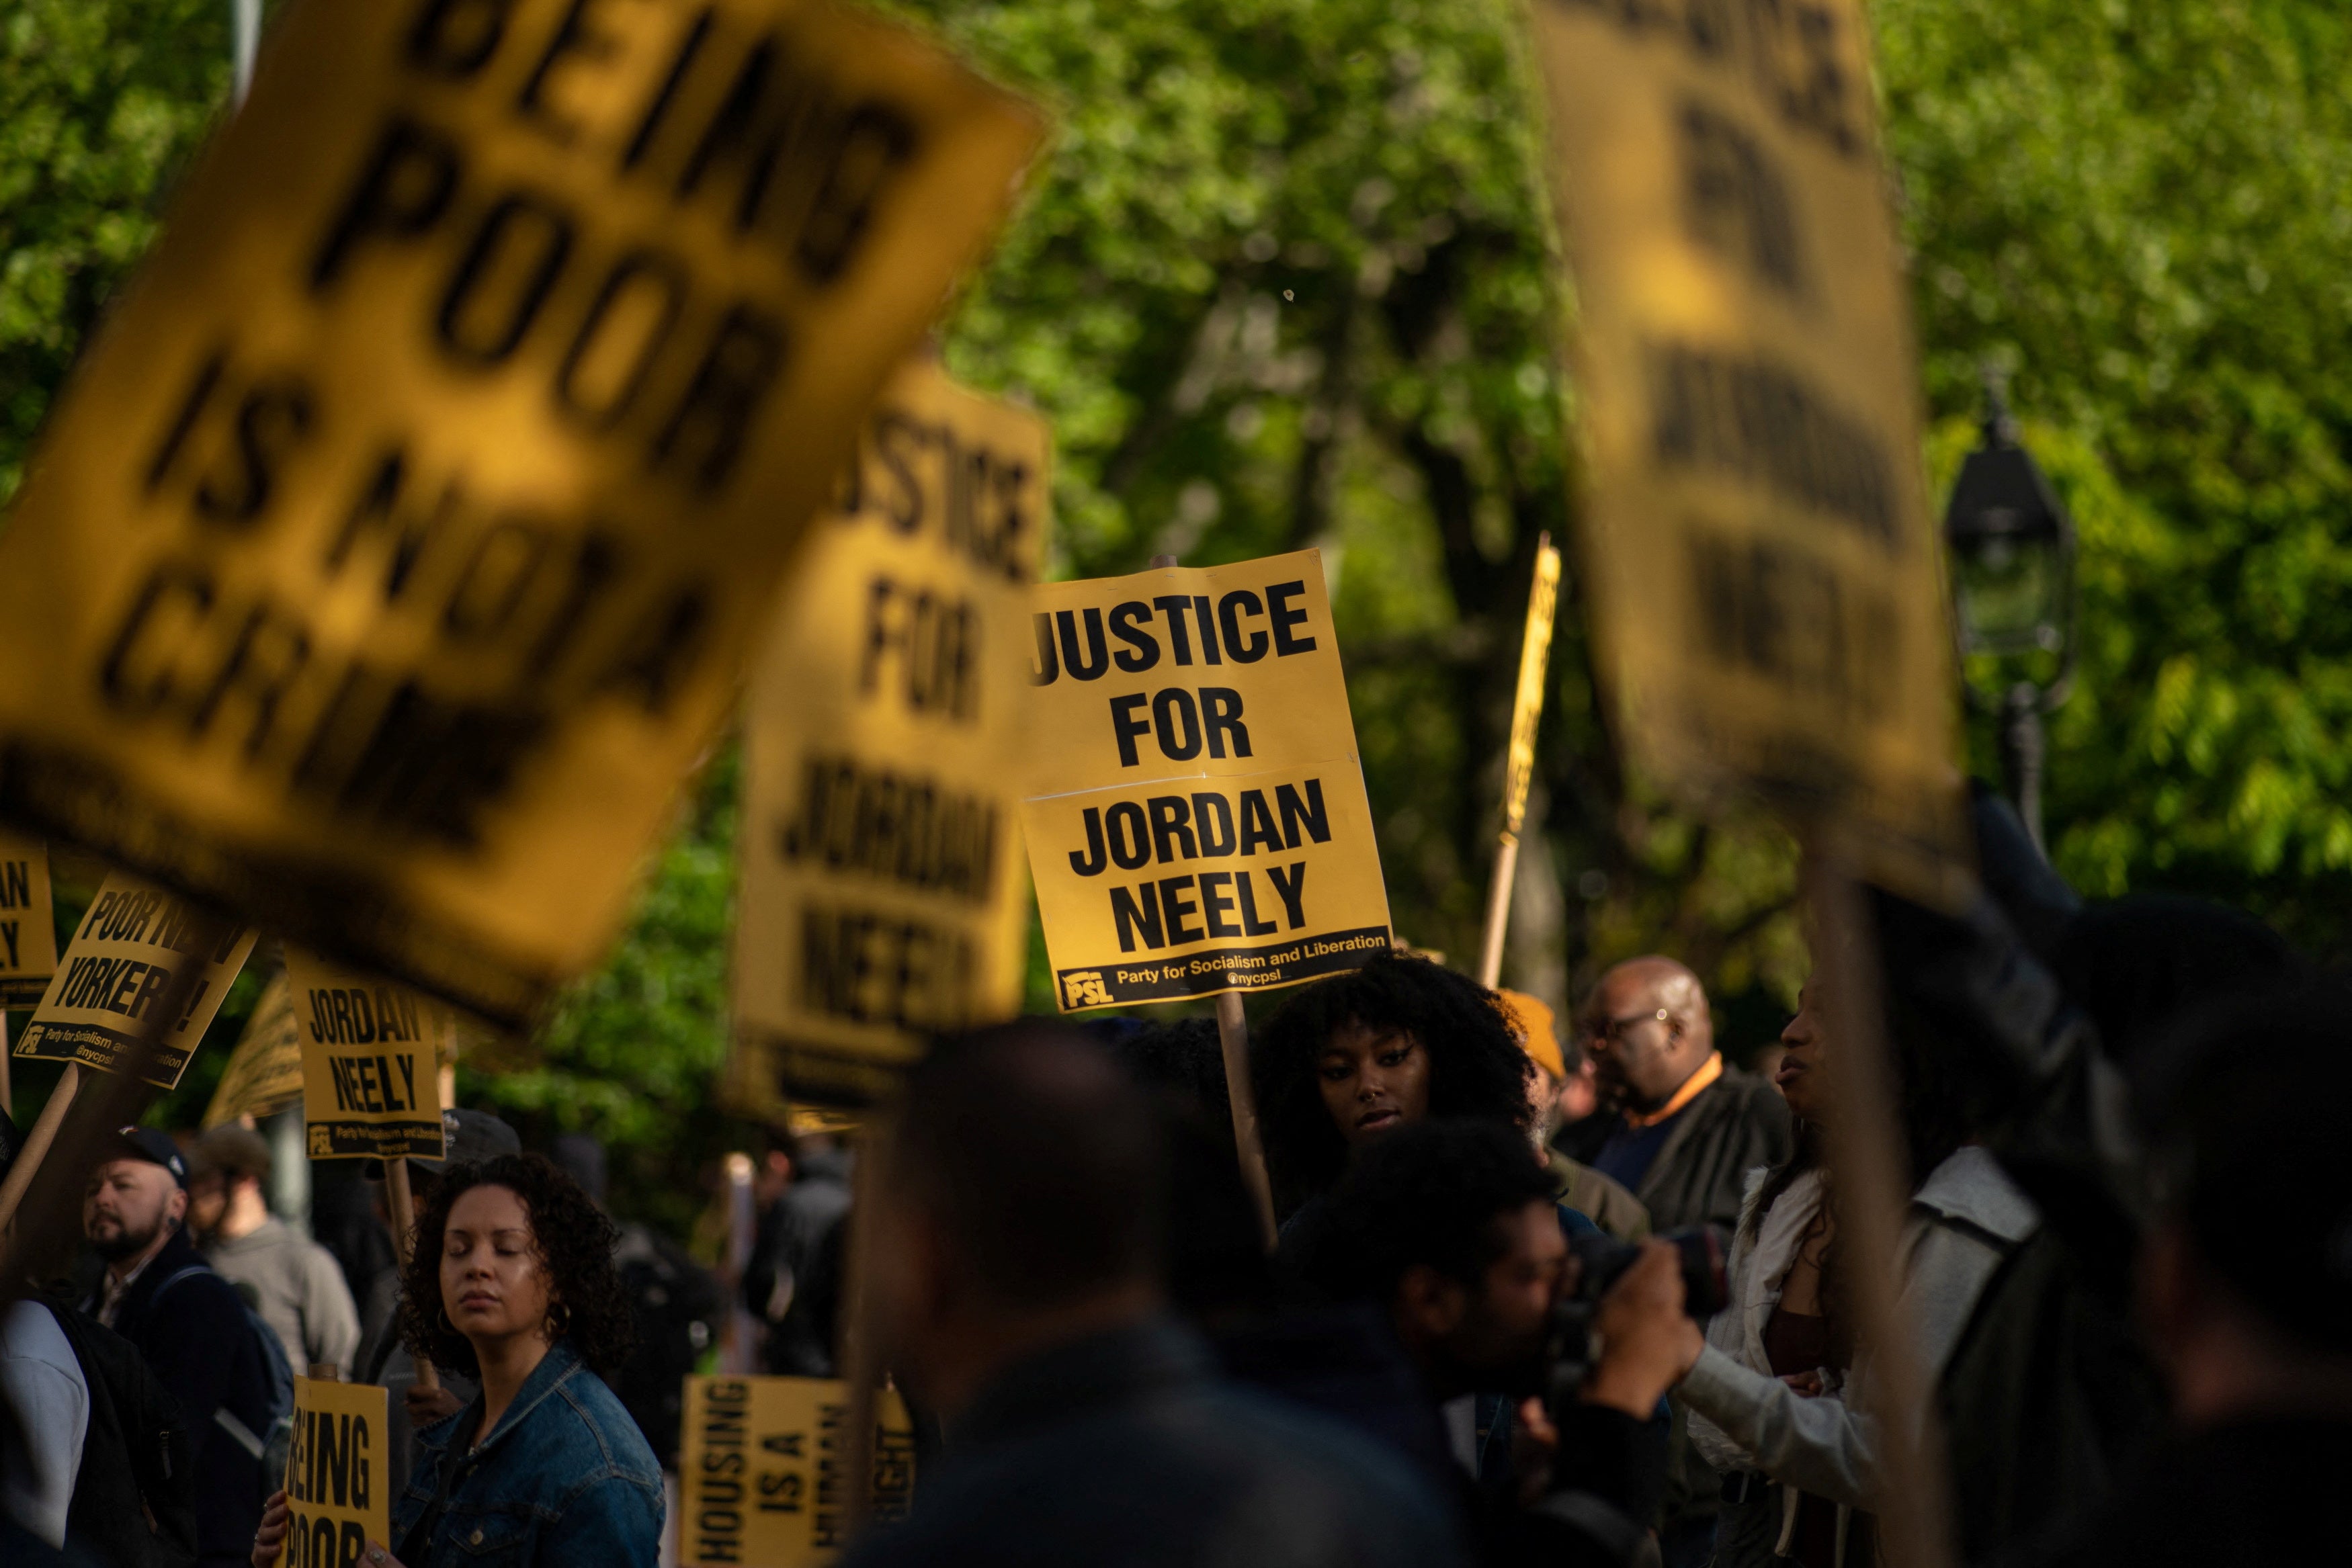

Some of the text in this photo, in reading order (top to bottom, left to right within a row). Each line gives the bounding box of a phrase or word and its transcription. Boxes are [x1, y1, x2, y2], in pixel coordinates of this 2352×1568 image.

[306, 111, 796, 500] POOR
[138, 339, 319, 527] IS
[853, 574, 986, 729] FOR
[1030, 580, 1318, 687] JUSTICE
[1109, 687, 1255, 768] FOR
[1068, 777, 1333, 877] JORDAN
[81, 890, 164, 942] POOR
[1109, 861, 1307, 953] NEELY
[1066, 974, 1115, 1008] PSL
[1117, 934, 1386, 986] Party for Socialism and Liberation
[1225, 968, 1282, 986] @nycpsl
[44, 1028, 64, 1043] Party
[63, 1029, 77, 1041] for
[75, 1030, 112, 1049] Socialism
[75, 1044, 115, 1065] @nycpsl
[309, 986, 422, 1044] JORDAN
[329, 1053, 416, 1113] NEELY
[287, 1406, 370, 1511] BEING
[698, 1381, 747, 1563] HOUSING
[759, 1434, 804, 1512] IS A
